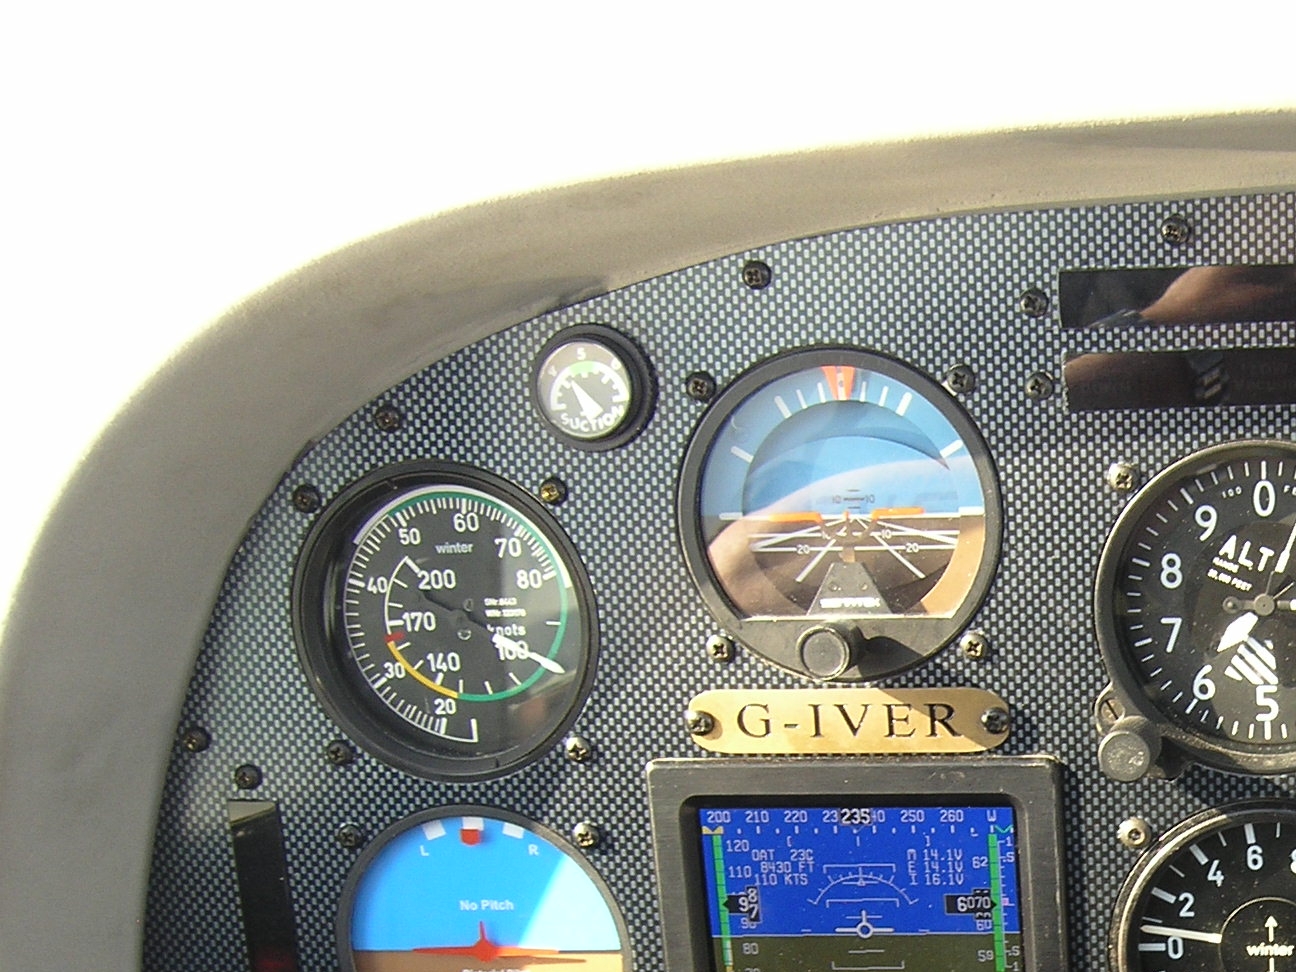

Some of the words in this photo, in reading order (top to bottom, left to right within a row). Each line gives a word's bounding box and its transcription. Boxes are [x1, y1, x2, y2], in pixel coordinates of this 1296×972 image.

[560, 405, 625, 433] SUCTION
[1253, 481, 1276, 517] 0
[453, 513, 480, 532] 60
[399, 527, 421, 546] 50
[495, 538, 521, 557] 70
[1218, 535, 1274, 572] ALT
[417, 570, 456, 589] 200
[516, 570, 542, 589] 80
[403, 612, 436, 632] 170
[427, 652, 460, 672] 140
[1192, 665, 1215, 700] 6
[434, 698, 456, 715] 20
[1255, 685, 1279, 721] 5
[737, 702, 964, 738] G-IVER
[707, 811, 731, 823] 200
[745, 811, 769, 823] 210
[784, 811, 808, 823] 220
[840, 808, 870, 824] 235
[900, 810, 925, 822] 250
[940, 810, 964, 822] 260
[726, 840, 749, 852] 120
[923, 849, 963, 861] 14.1V
[760, 862, 791, 873] 8430
[799, 861, 814, 873] FT
[972, 857, 989, 868] 62
[1247, 845, 1264, 870] 6
[729, 866, 751, 878] 110
[924, 862, 963, 873] 14.1V
[1207, 860, 1224, 887] 4
[460, 900, 478, 911] No
[481, 899, 514, 911] Pitch
[1178, 893, 1195, 917] 2
[1247, 943, 1295, 957] winter
